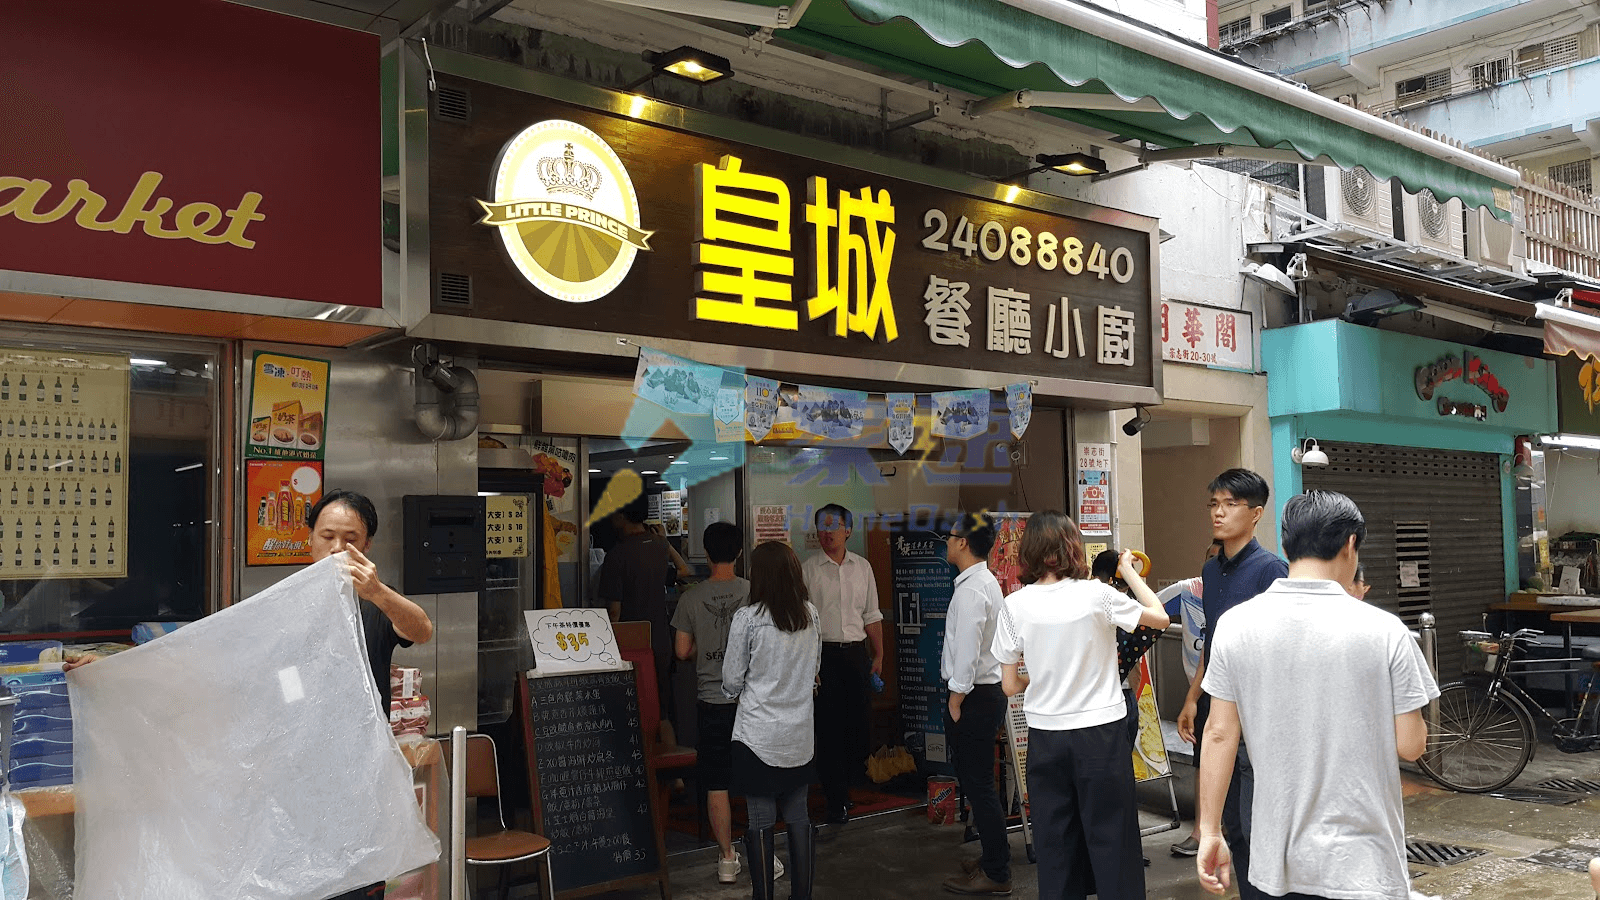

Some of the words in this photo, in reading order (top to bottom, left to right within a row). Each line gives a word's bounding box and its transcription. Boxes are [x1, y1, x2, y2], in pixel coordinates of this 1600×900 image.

[505, 203, 562, 219] LITTLE
[565, 205, 628, 240] PRINCE
[694, 155, 899, 343] 皇城
[921, 208, 1135, 284] 24088840
[923, 275, 1136, 367] 餐廳小廚
[1080, 458, 1109, 468] 28號地下
[1083, 446, 1105, 456] 崇志街
[556, 632, 590, 652] $35
[706, 651, 726, 660] SEA
